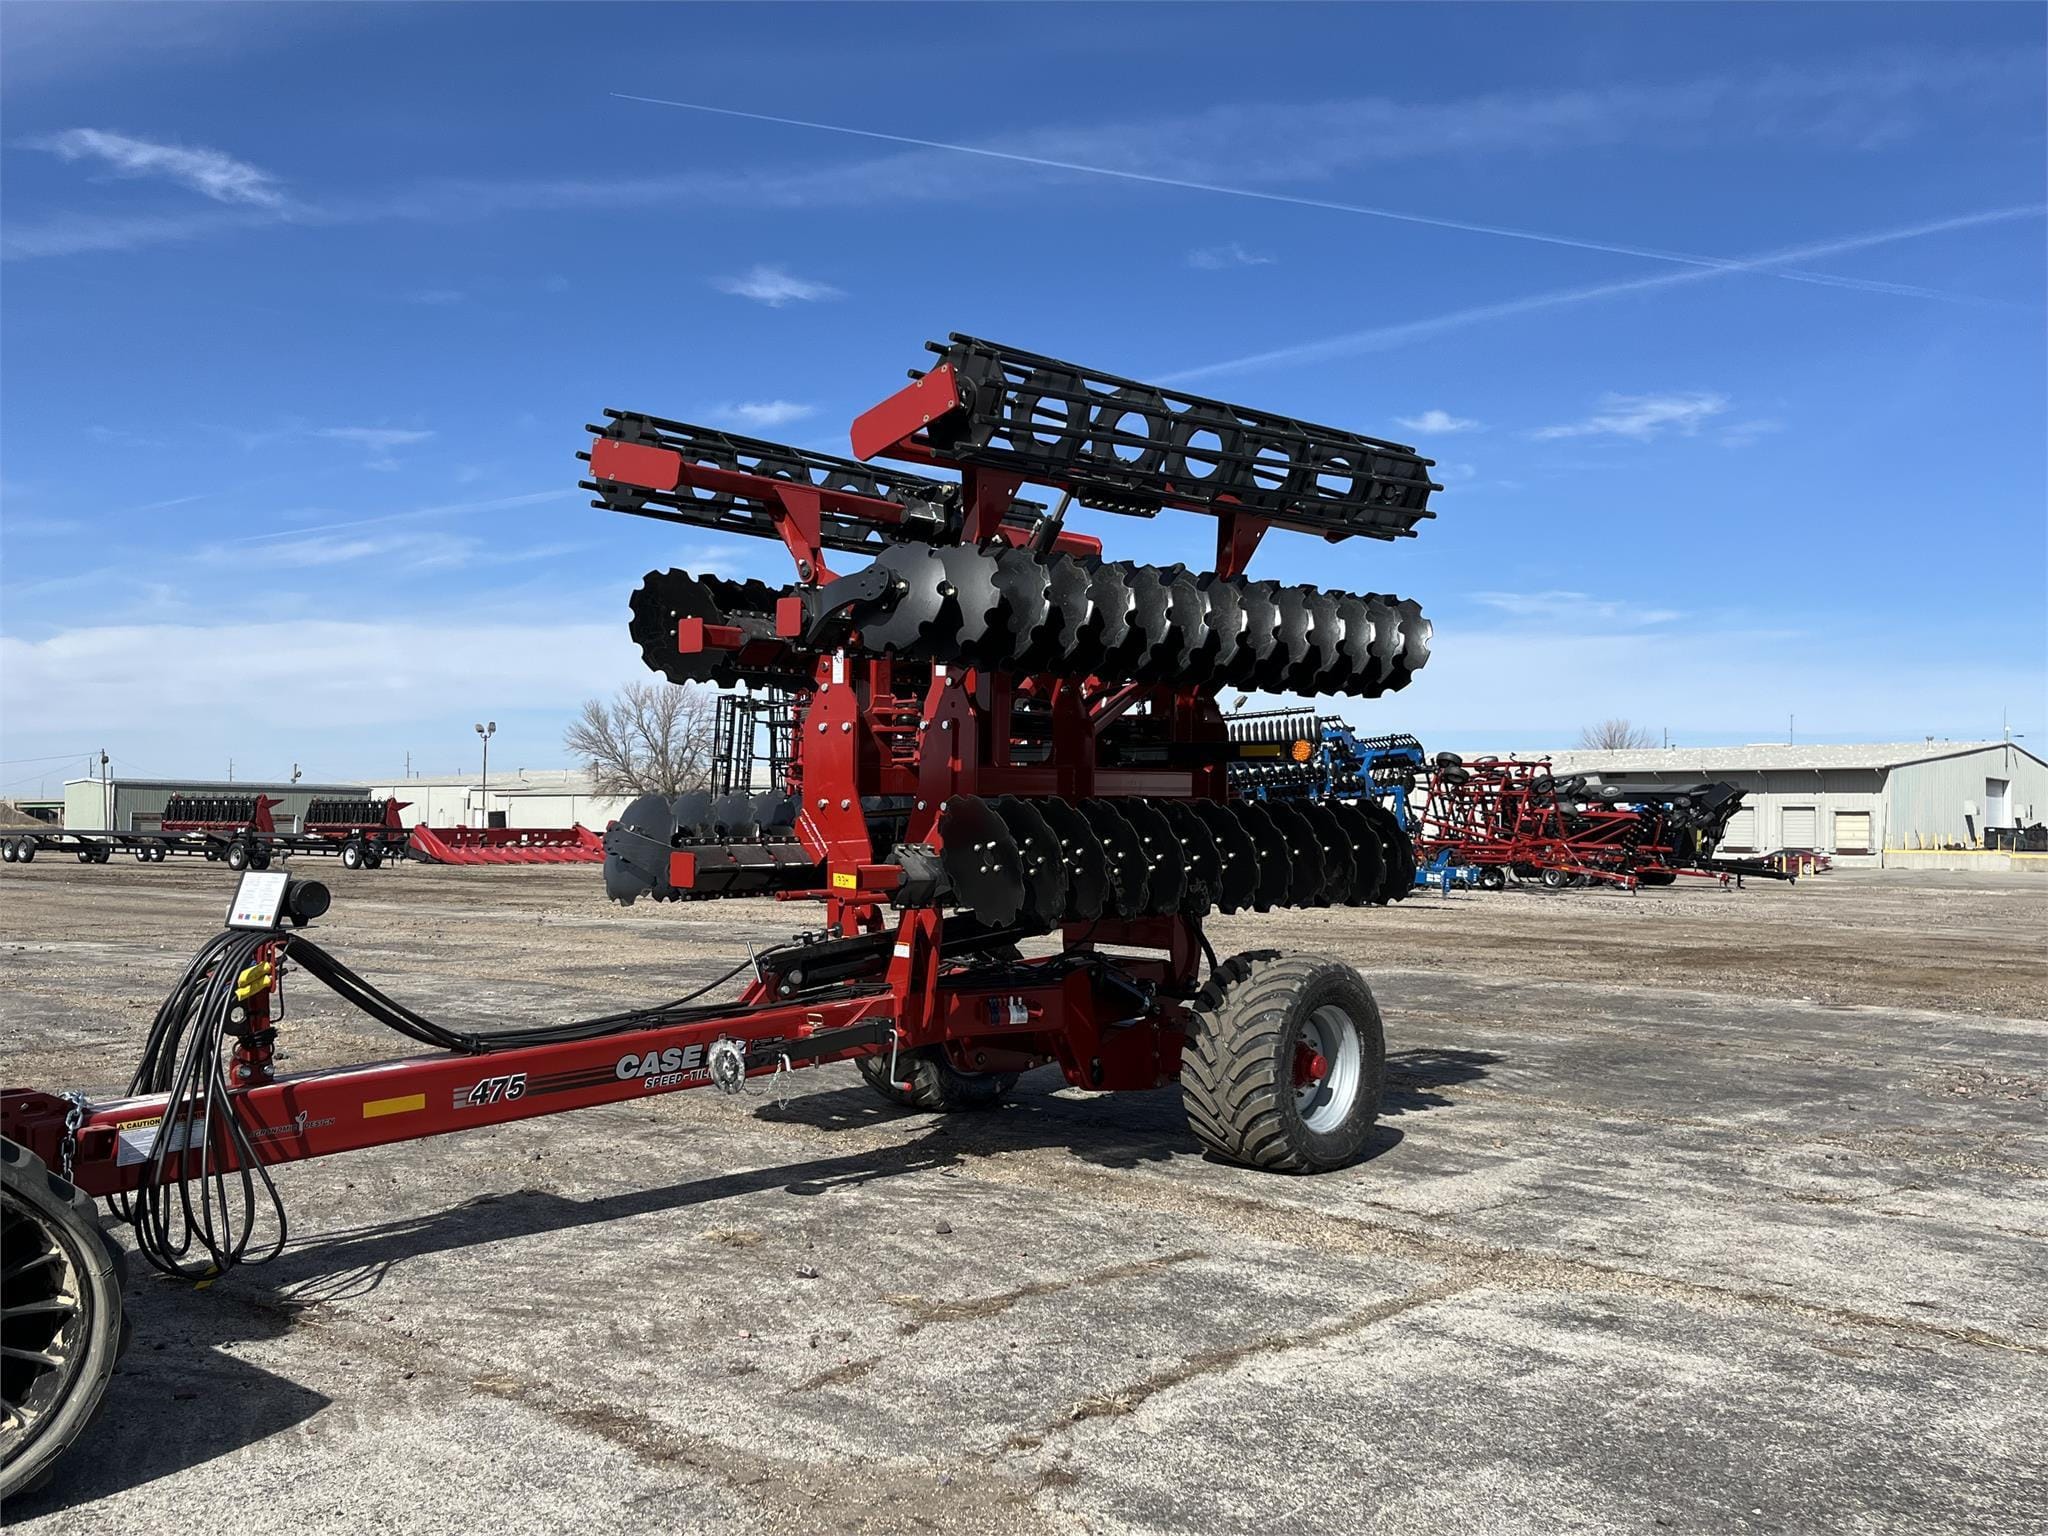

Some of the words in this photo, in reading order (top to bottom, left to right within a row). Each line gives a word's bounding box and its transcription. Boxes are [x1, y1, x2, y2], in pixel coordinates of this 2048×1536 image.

[616, 1044, 703, 1080] CASE
[467, 1072, 528, 1106] 475
[126, 1118, 160, 1130] CAUTION
[304, 1117, 336, 1129] DESIGN
